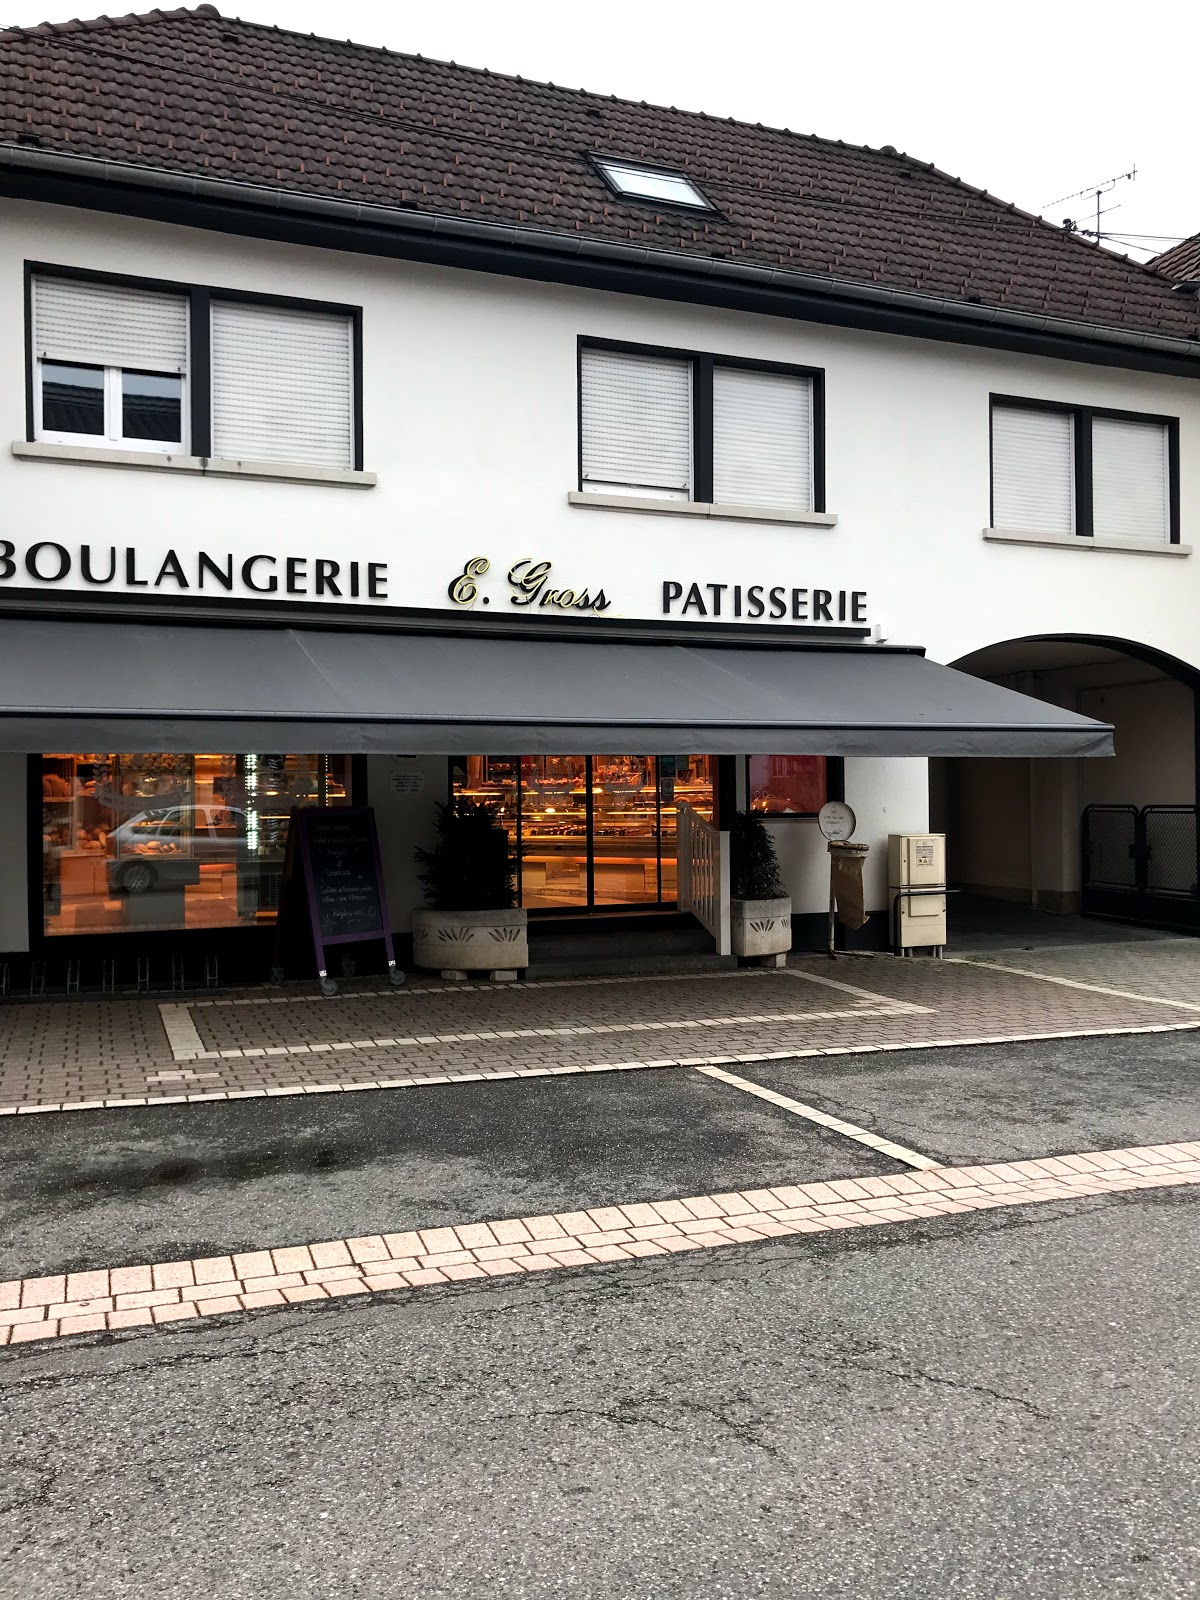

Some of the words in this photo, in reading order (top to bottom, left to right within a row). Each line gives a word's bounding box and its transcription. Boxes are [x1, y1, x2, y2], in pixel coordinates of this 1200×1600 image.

[0, 539, 389, 599] BOULANGERIE
[448, 556, 490, 605] E.
[507, 557, 613, 611] Gross
[662, 580, 868, 622] PATISSERIE
